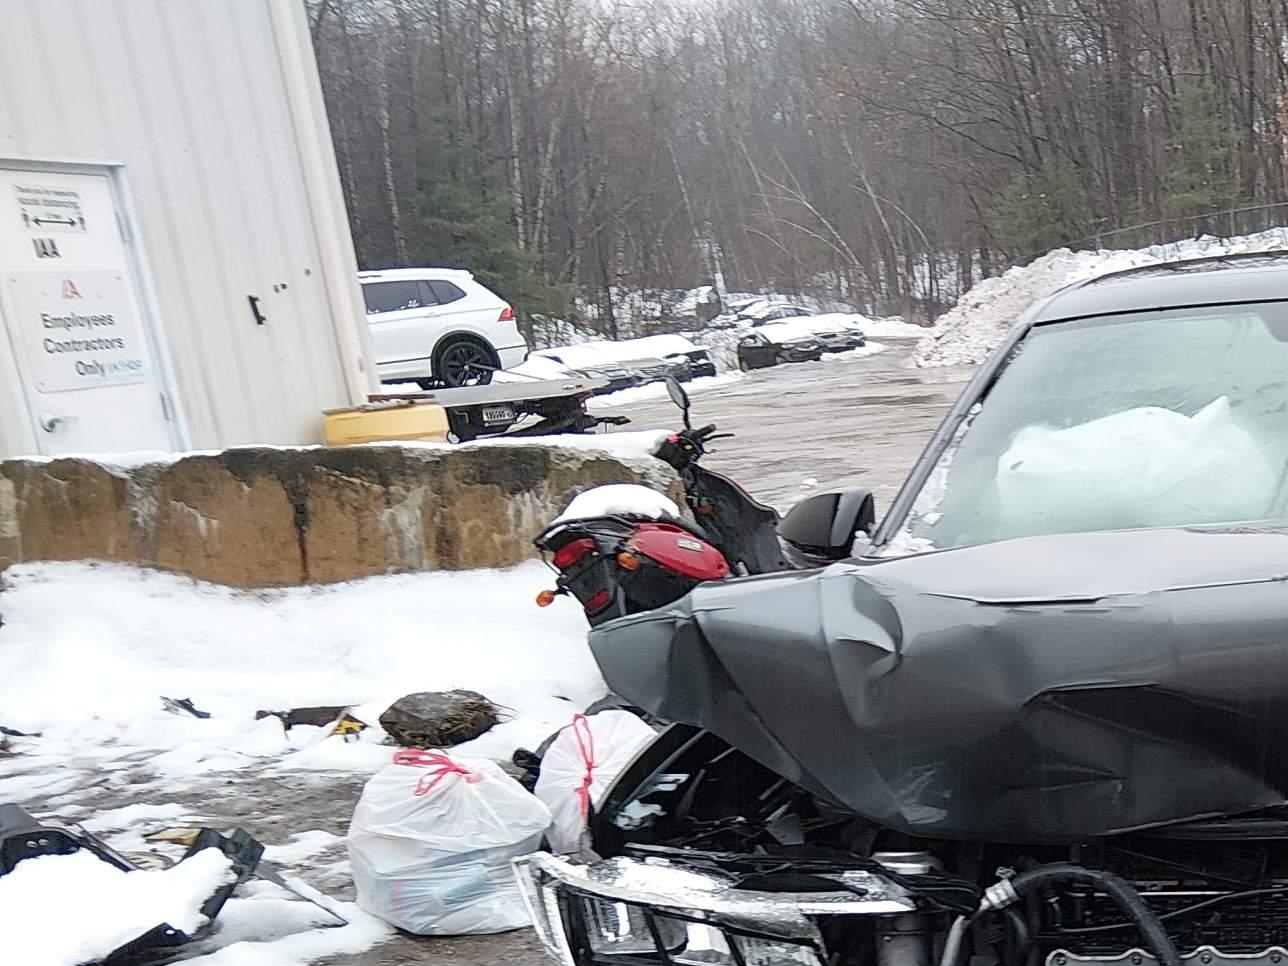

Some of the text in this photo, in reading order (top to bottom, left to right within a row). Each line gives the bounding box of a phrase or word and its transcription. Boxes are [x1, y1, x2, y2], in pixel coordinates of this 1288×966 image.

[40, 312, 115, 332] Employees
[43, 337, 126, 354] Contractors
[75, 359, 105, 377] Only
